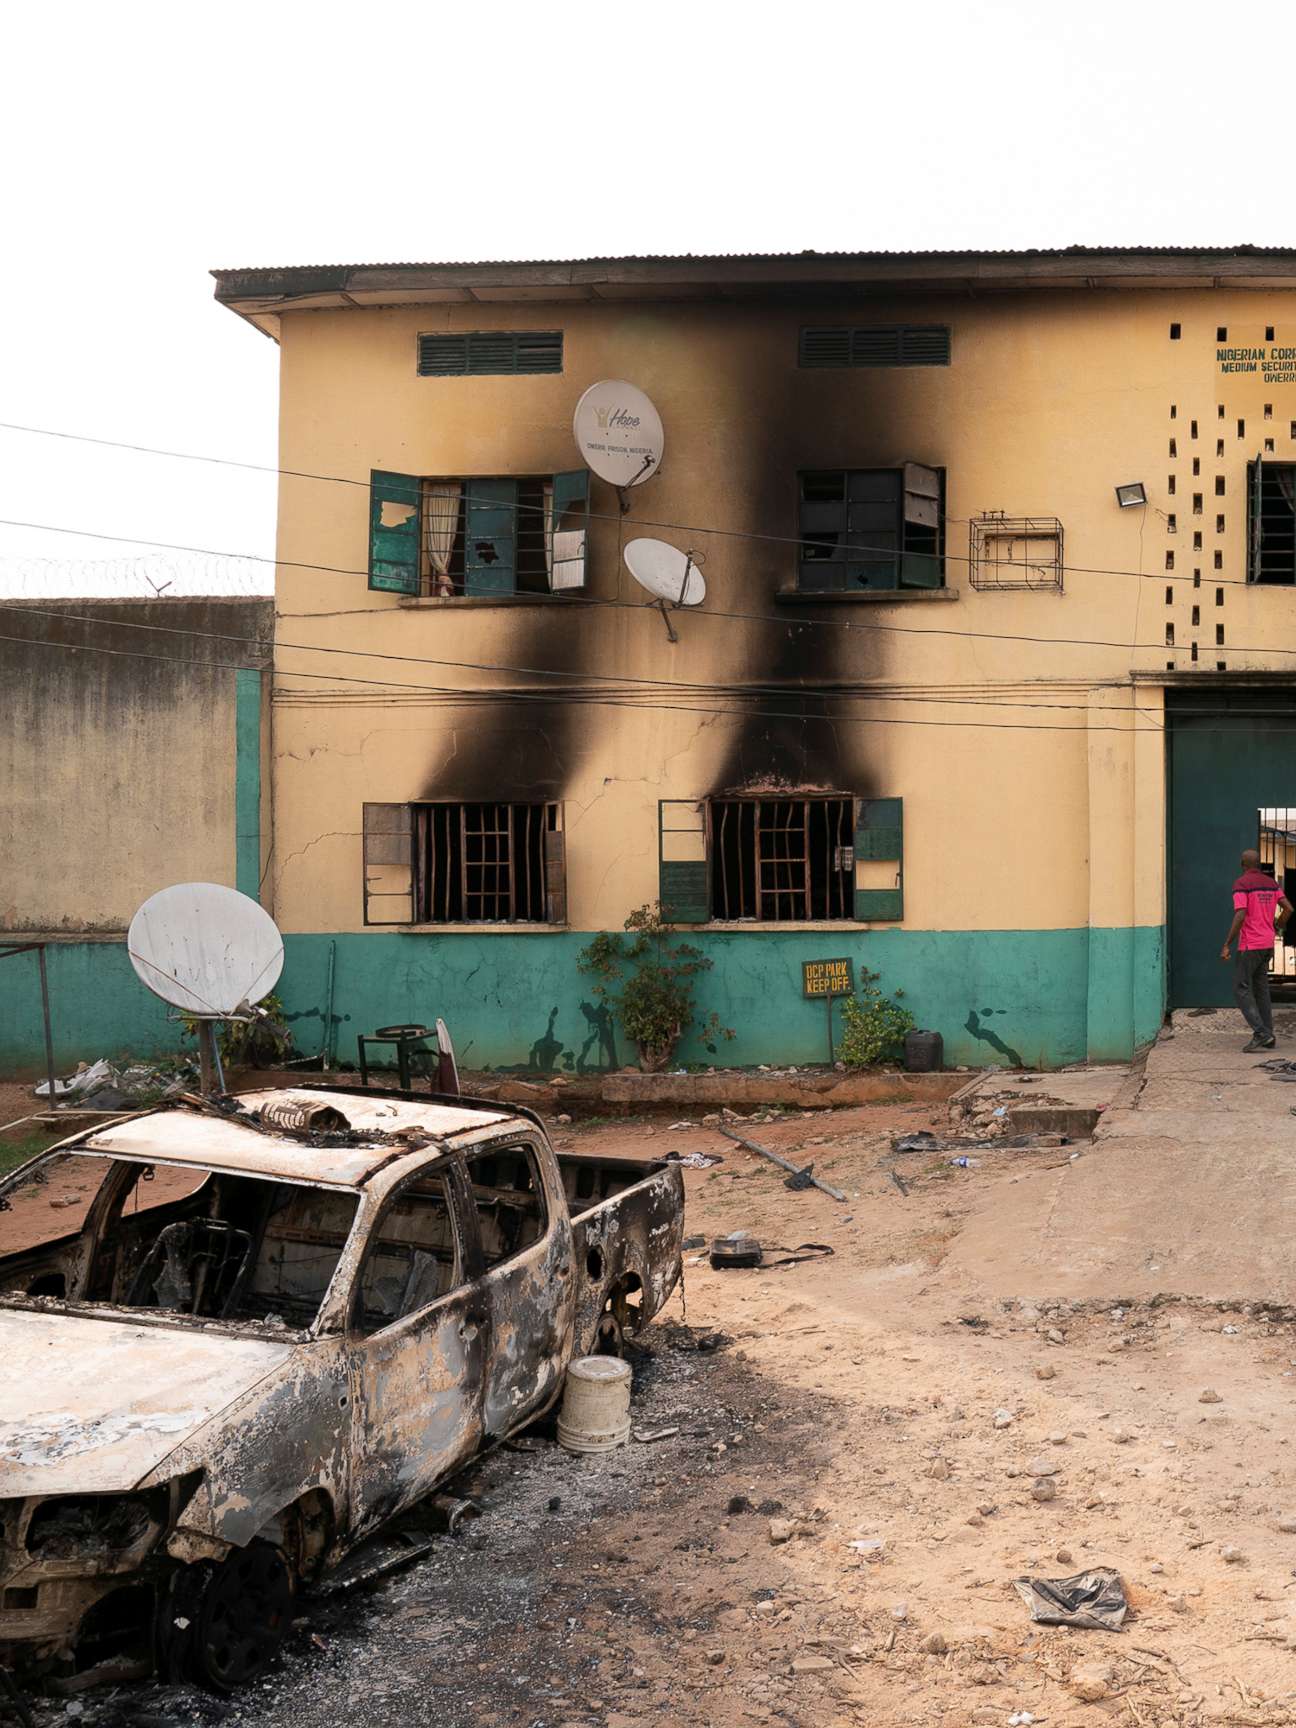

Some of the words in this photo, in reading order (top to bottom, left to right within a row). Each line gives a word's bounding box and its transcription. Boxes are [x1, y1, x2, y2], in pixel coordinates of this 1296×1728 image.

[1216, 348, 1265, 361] NIGERIAN
[1221, 362, 1257, 373] MEDIUM
[1264, 372, 1296, 383] OWERRI
[609, 408, 640, 428] Hope
[825, 961, 847, 977] PARK
[807, 978, 830, 993] KEEP
